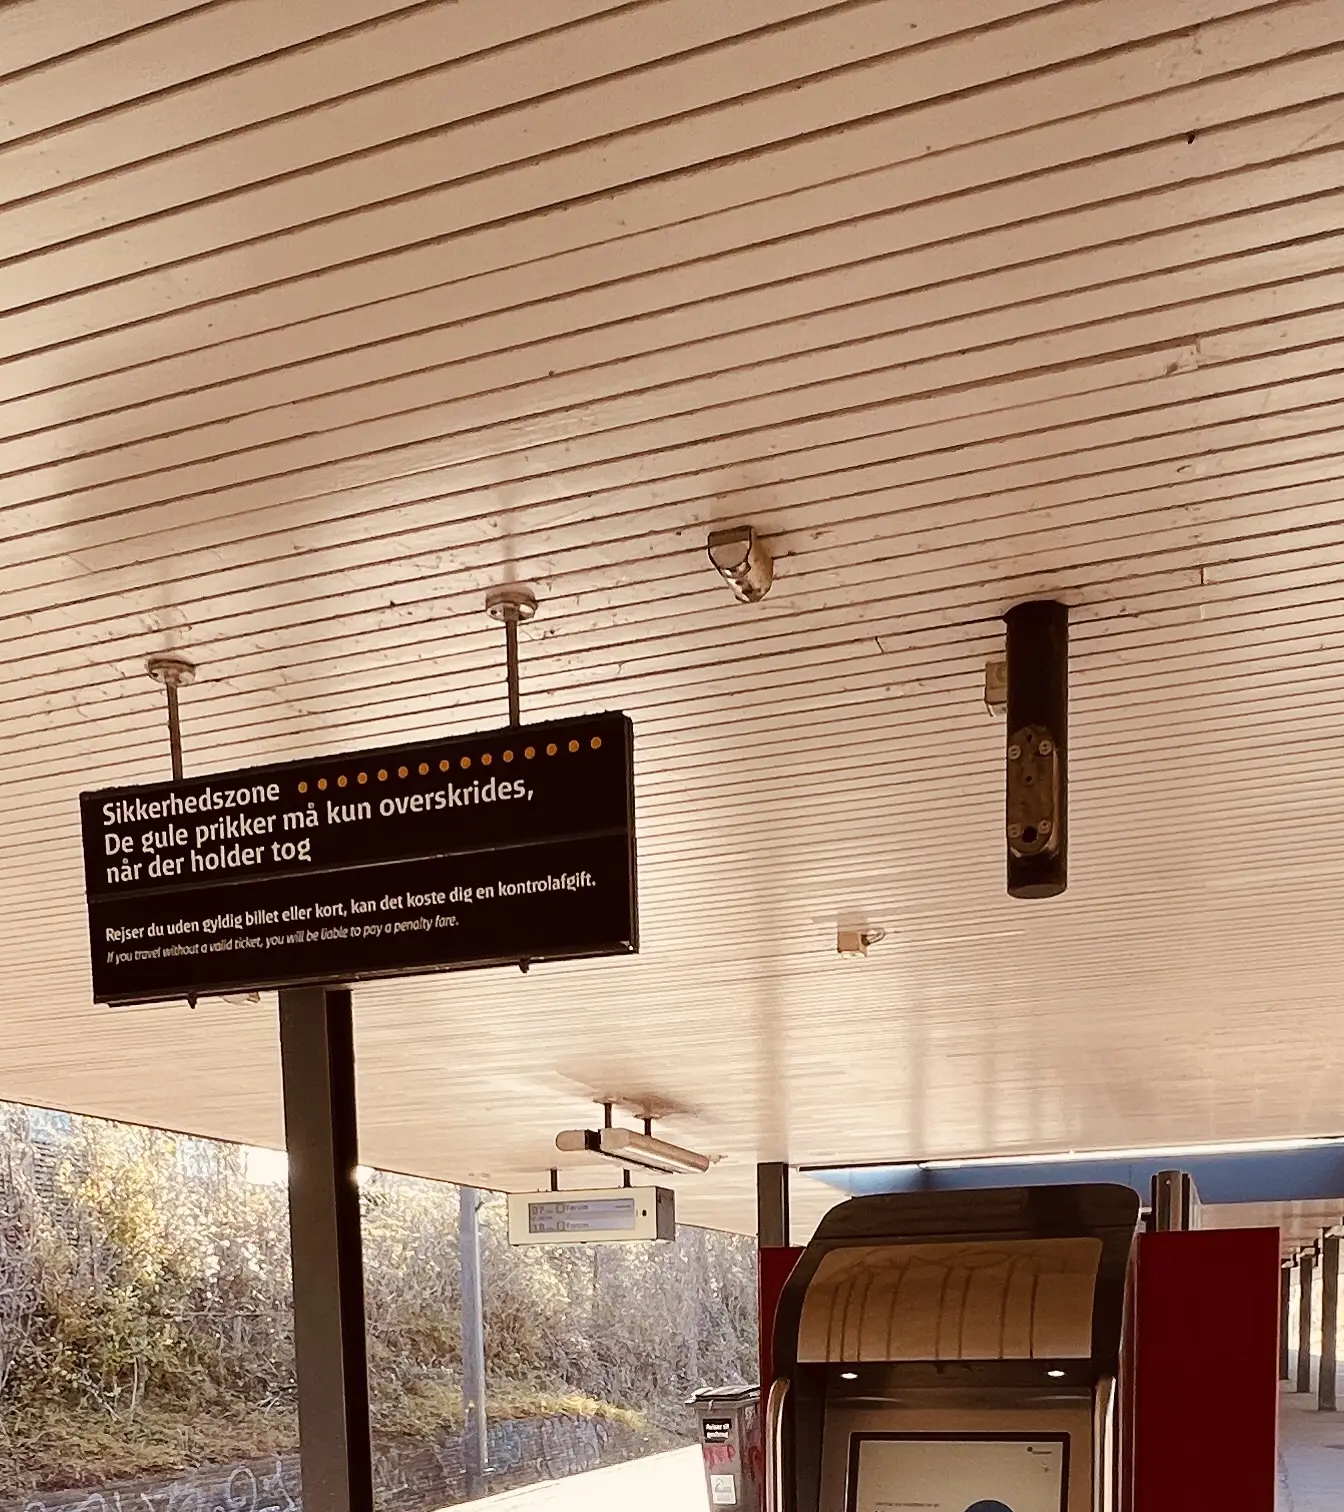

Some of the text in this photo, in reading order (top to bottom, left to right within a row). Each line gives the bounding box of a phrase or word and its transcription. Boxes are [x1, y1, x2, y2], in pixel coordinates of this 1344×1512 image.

[103, 784, 279, 825] Sikkerhedszone
[105, 777, 533, 855] De gule prikker må kun overskrides,
[106, 838, 311, 884] når der holder tog
[105, 870, 597, 943] Rejser du uden gyldig billet eller kort, kan det koste dig en kontrolafgift.
[106, 914, 459, 966] If you travel without a valid ticket, you will be liable to pay a penalty fare.
